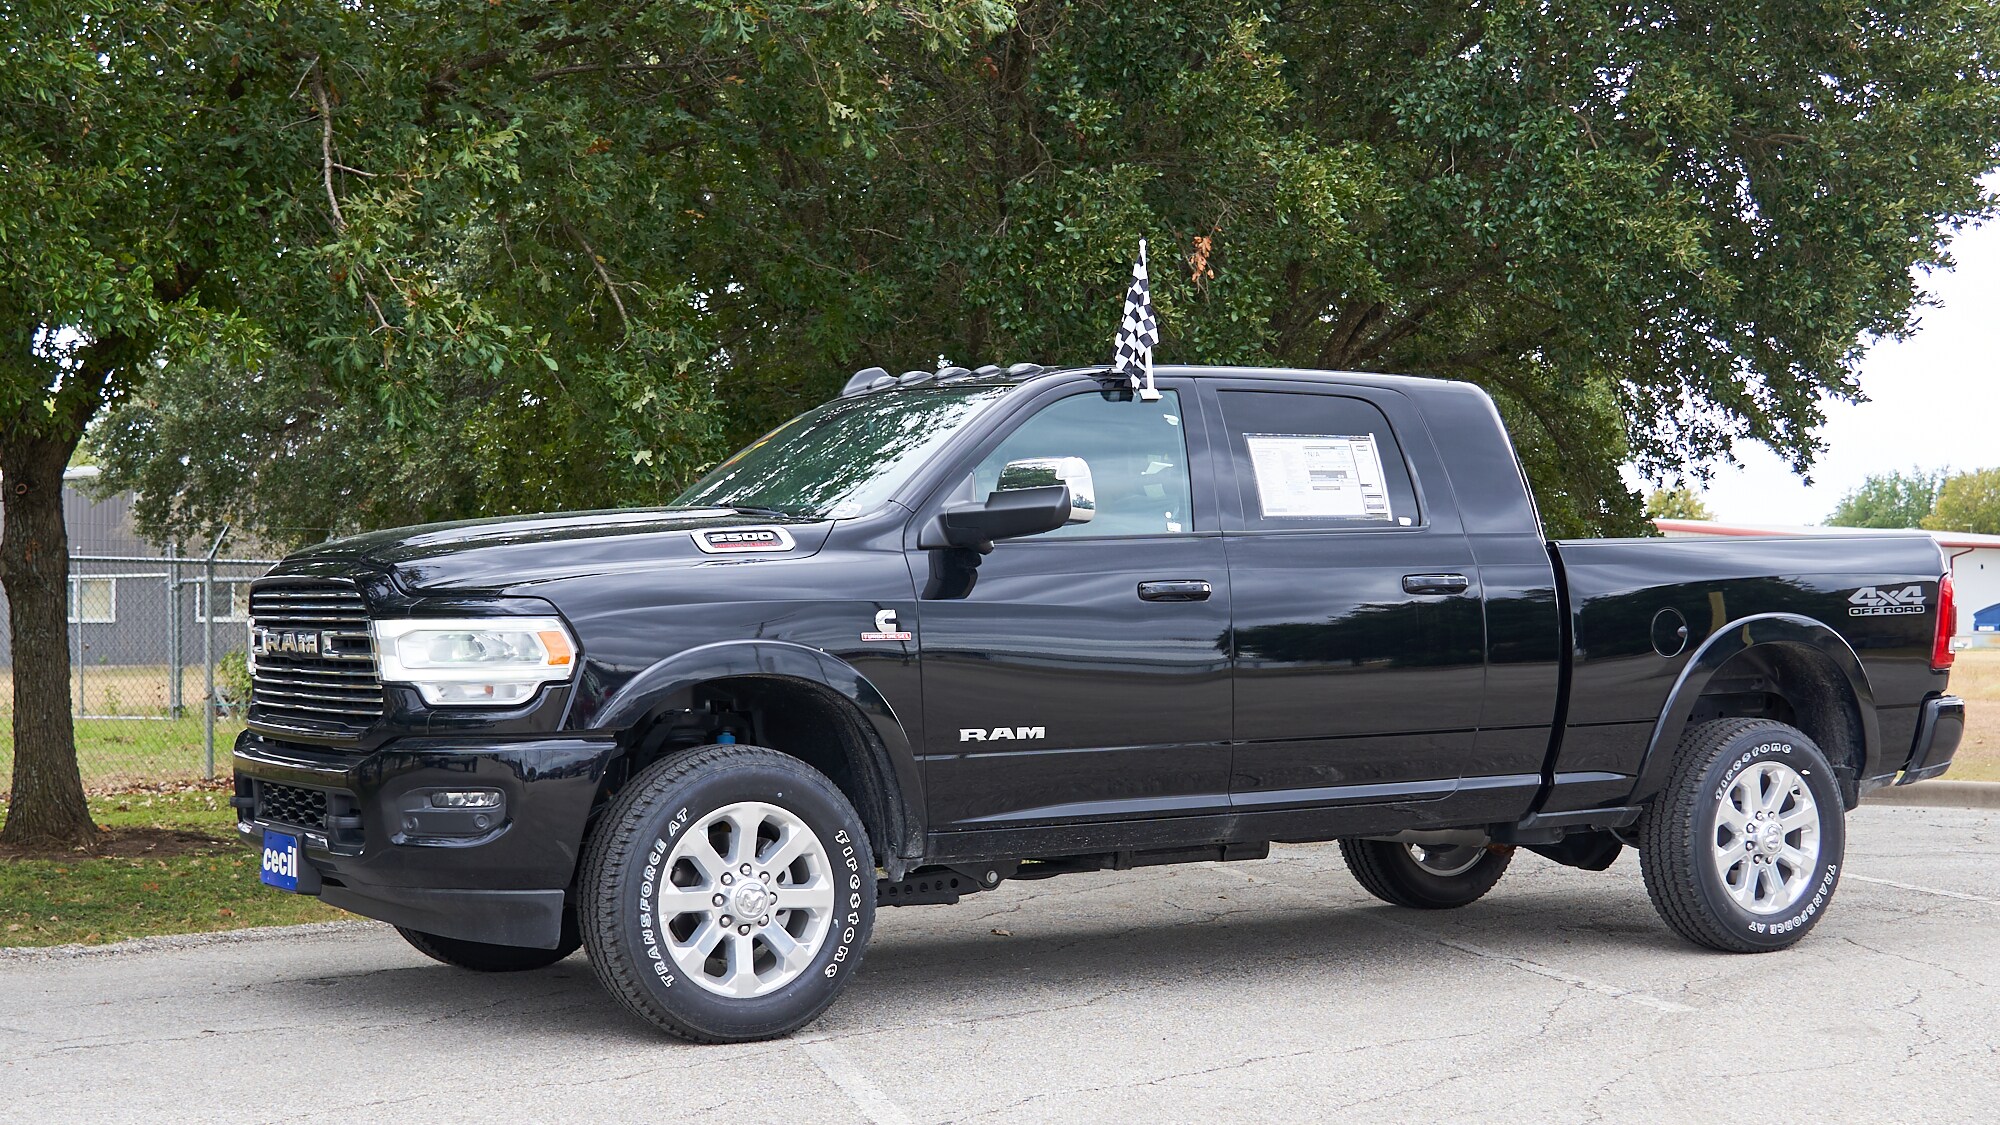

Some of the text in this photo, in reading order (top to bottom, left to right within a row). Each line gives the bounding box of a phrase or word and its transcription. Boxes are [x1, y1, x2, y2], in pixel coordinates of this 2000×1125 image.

[710, 532, 774, 543] 2500
[1847, 585, 1927, 606] 4x4
[1850, 606, 1924, 615] OFF ROAD
[265, 632, 318, 654] RAM
[959, 726, 1046, 742] RAM
[263, 845, 297, 878] cecil
[639, 807, 689, 988] TRANSFORCE AT
[1748, 864, 1836, 935] TRANSFORCE AT
